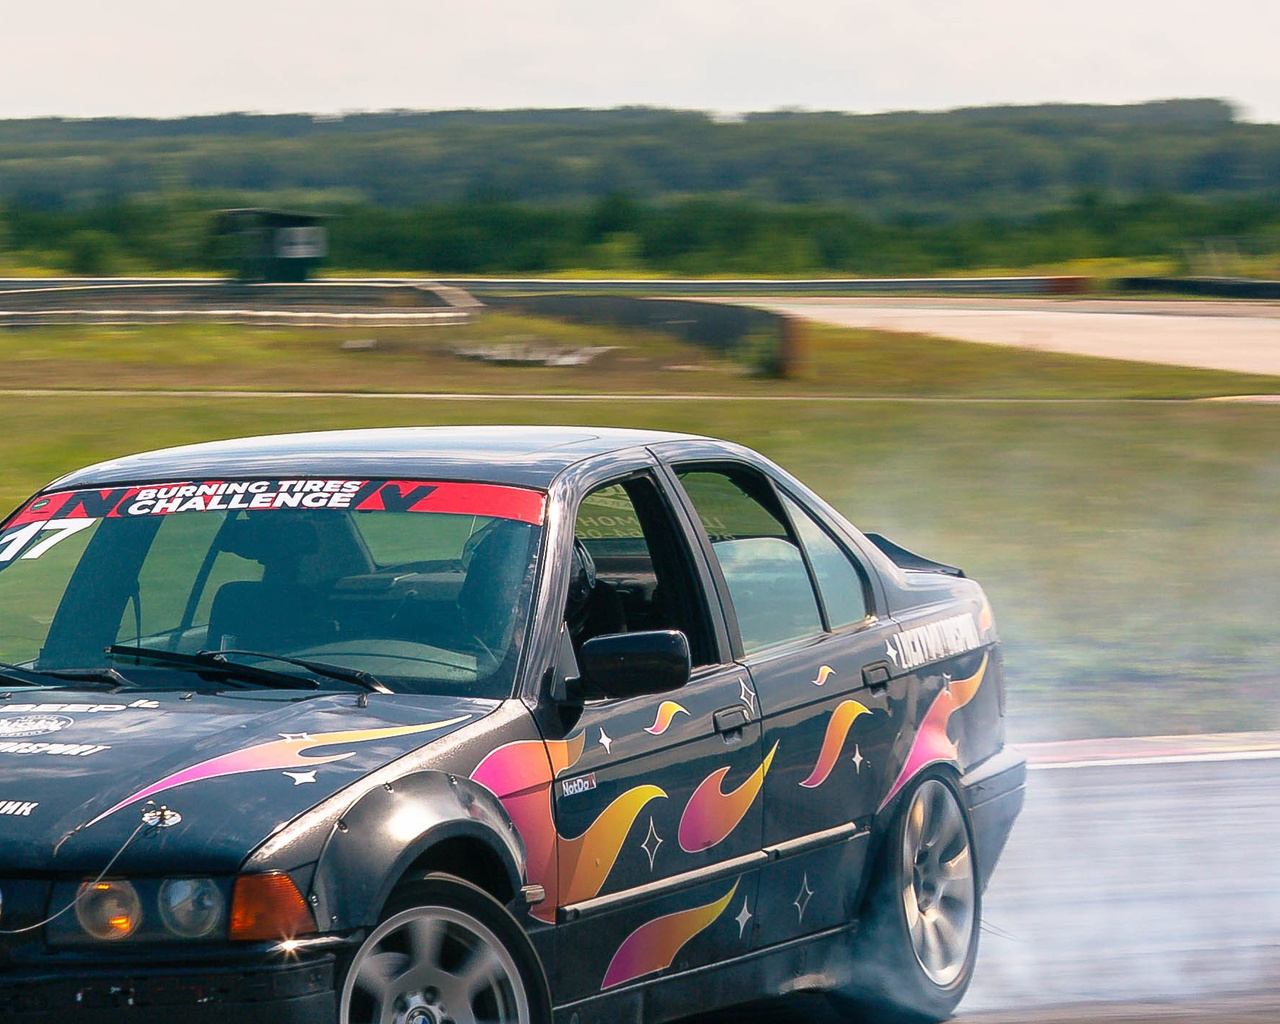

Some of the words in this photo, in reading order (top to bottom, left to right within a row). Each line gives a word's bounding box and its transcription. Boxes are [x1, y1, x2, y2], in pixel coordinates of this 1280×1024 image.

[135, 481, 271, 501] BURNING
[277, 480, 363, 494] TIRES
[127, 492, 357, 516] CHALLENGE
